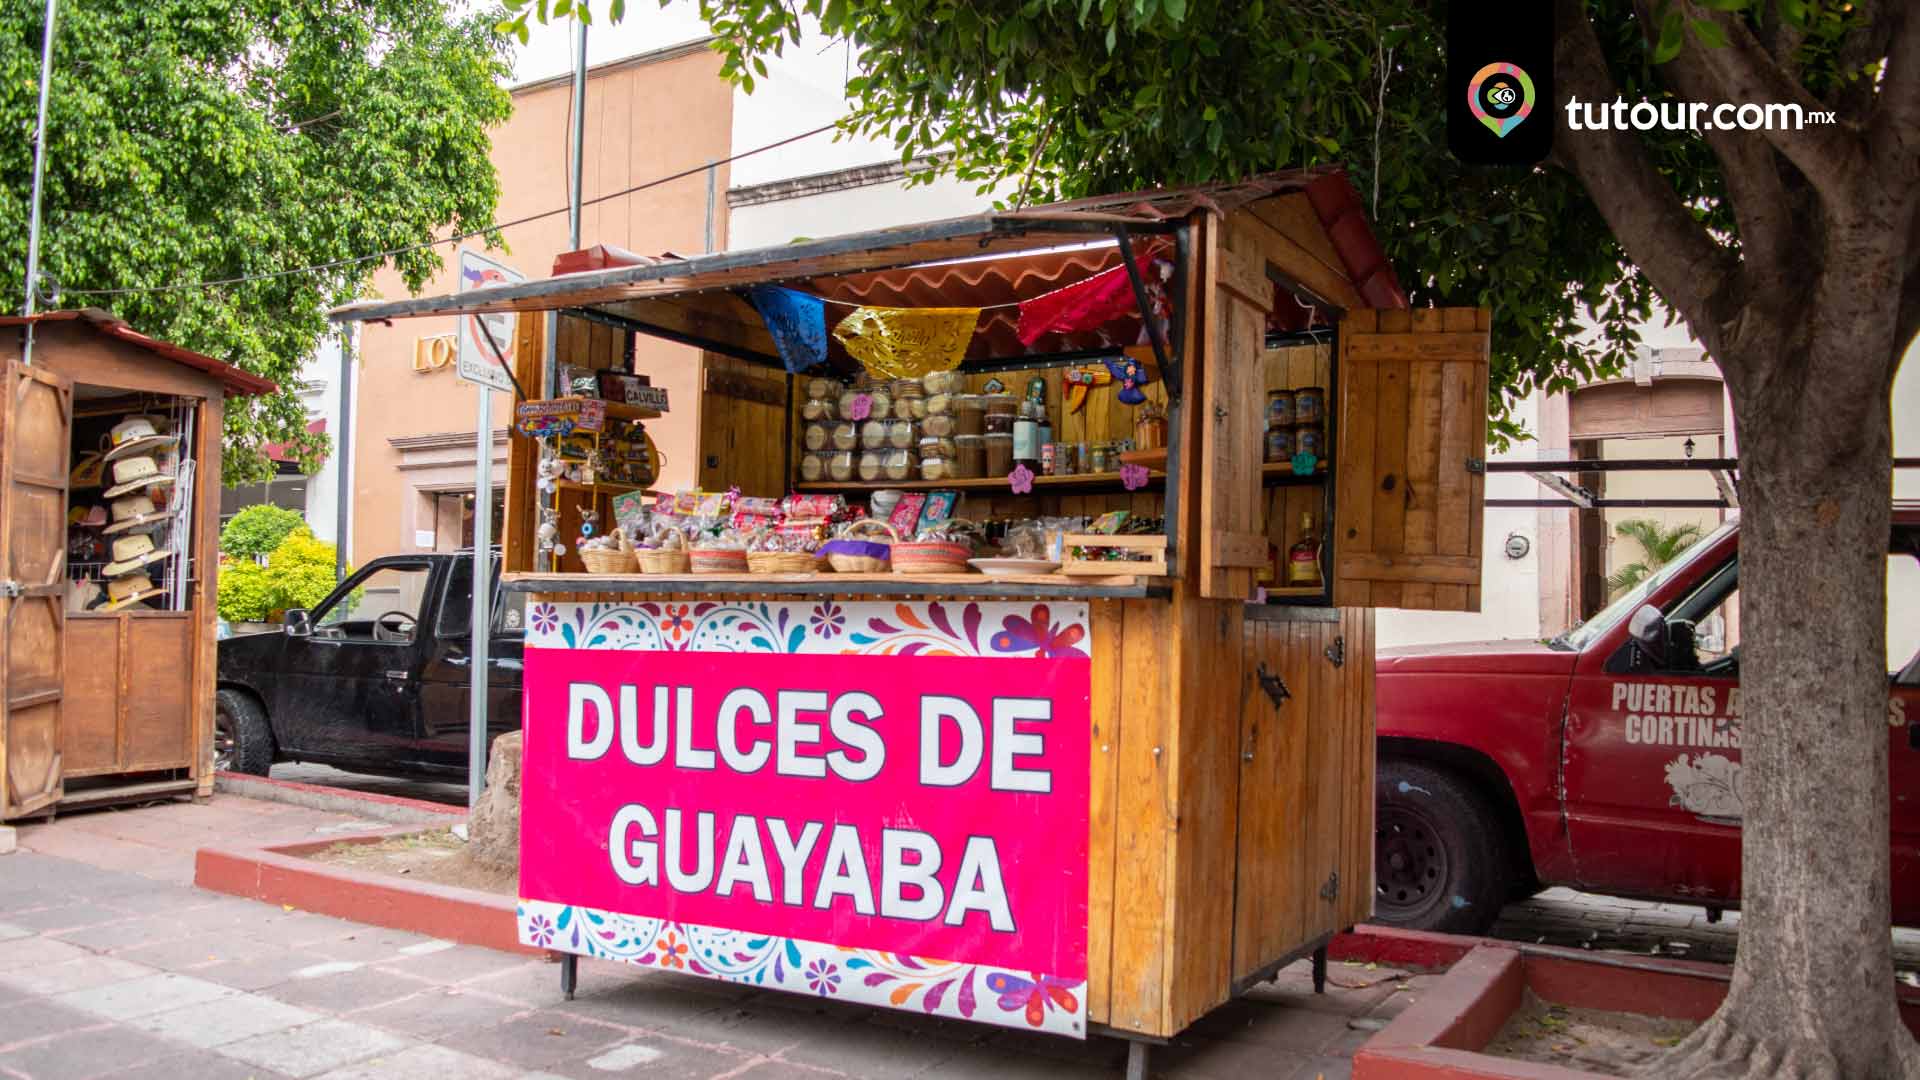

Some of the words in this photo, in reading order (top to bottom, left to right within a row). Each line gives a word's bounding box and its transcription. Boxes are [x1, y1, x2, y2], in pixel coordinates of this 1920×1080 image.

[567, 681, 886, 782] DULCES
[919, 694, 1053, 794] DE
[1611, 682, 1716, 716] PUERTAS
[608, 803, 1017, 933] GUAYABA
